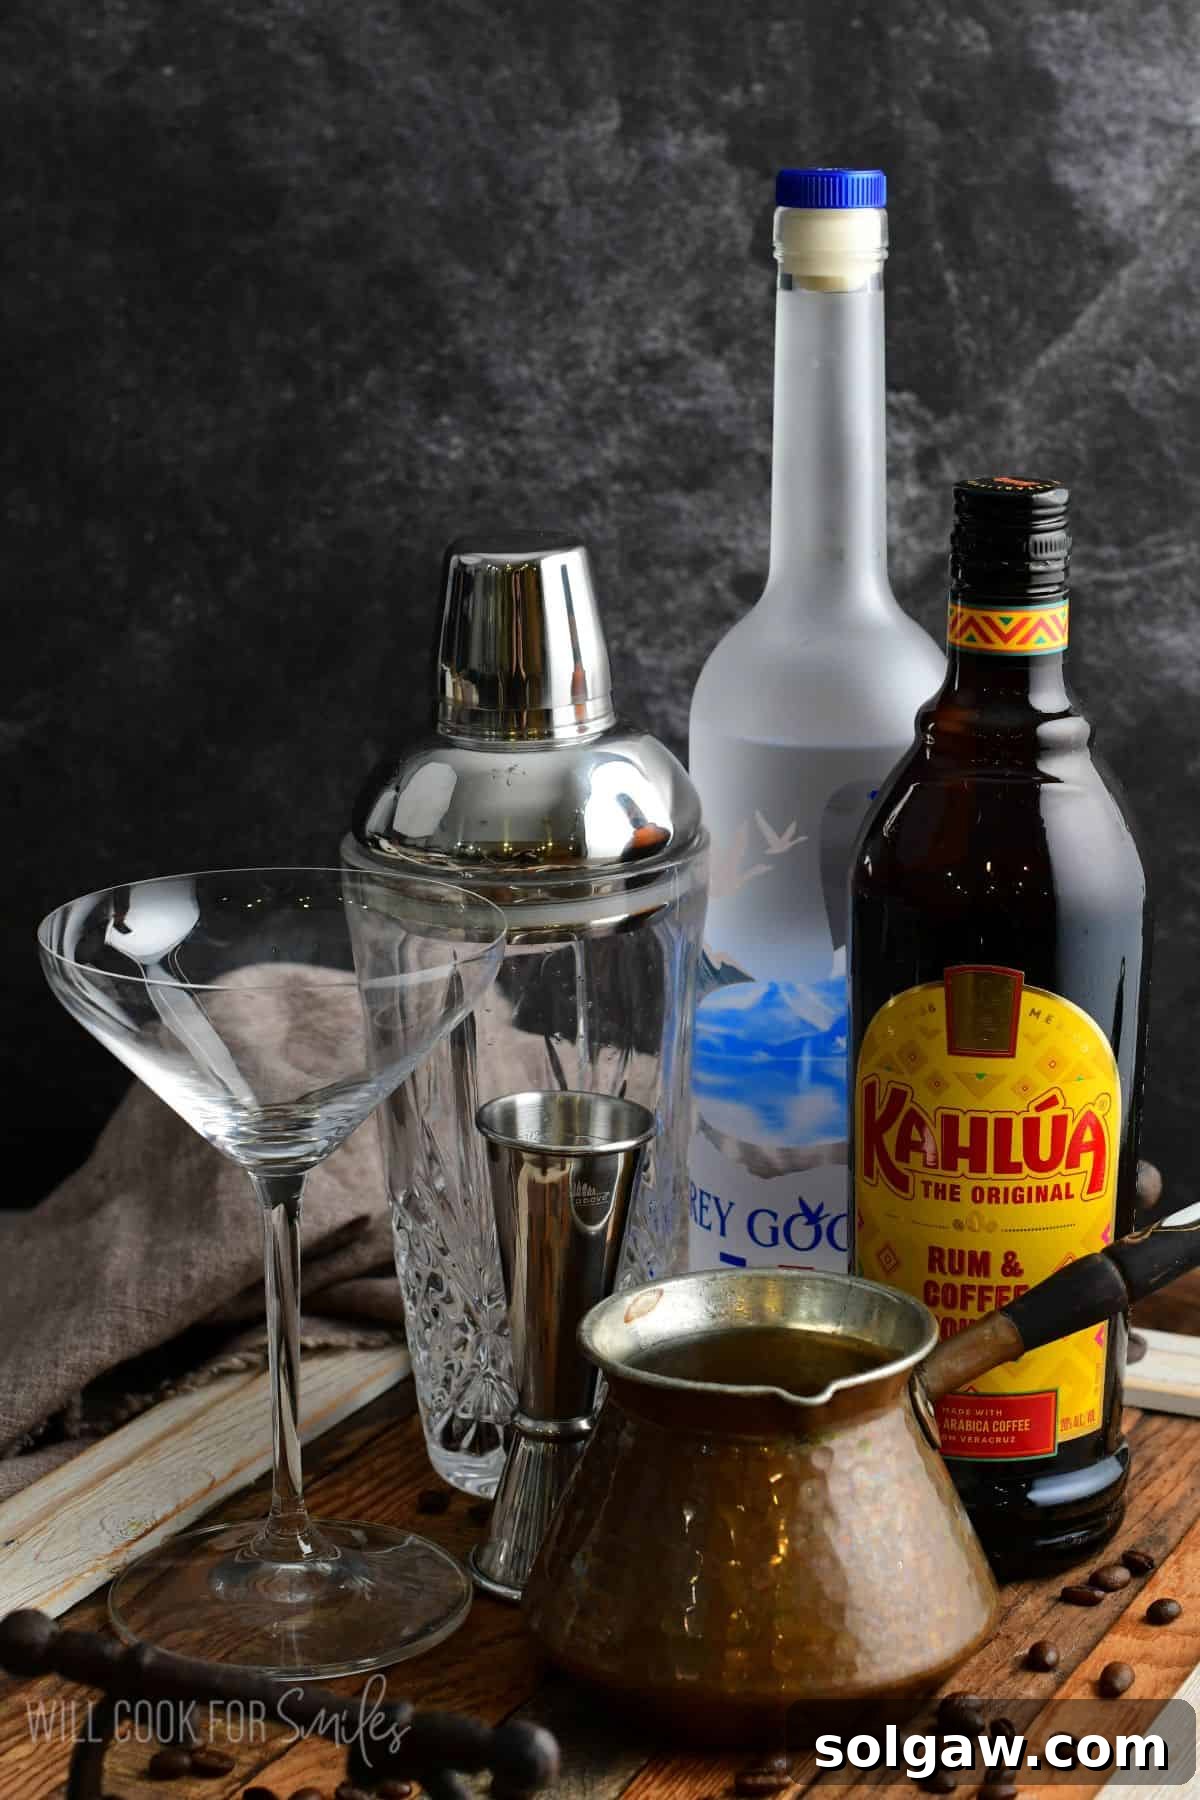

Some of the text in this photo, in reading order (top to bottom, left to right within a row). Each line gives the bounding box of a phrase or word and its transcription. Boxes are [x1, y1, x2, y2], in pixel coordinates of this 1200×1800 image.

[863, 1081, 1107, 1196] KAHLÚA
[921, 1180, 1074, 1205] THE ORIGINAL
[689, 1180, 849, 1253] REY GOO
[927, 1246, 1024, 1278] RUM &
[943, 1417, 1031, 1433] ARABICA COFFEE
[975, 1408, 1003, 1417] WITH
[960, 1435, 1016, 1445] VERACRUZ
